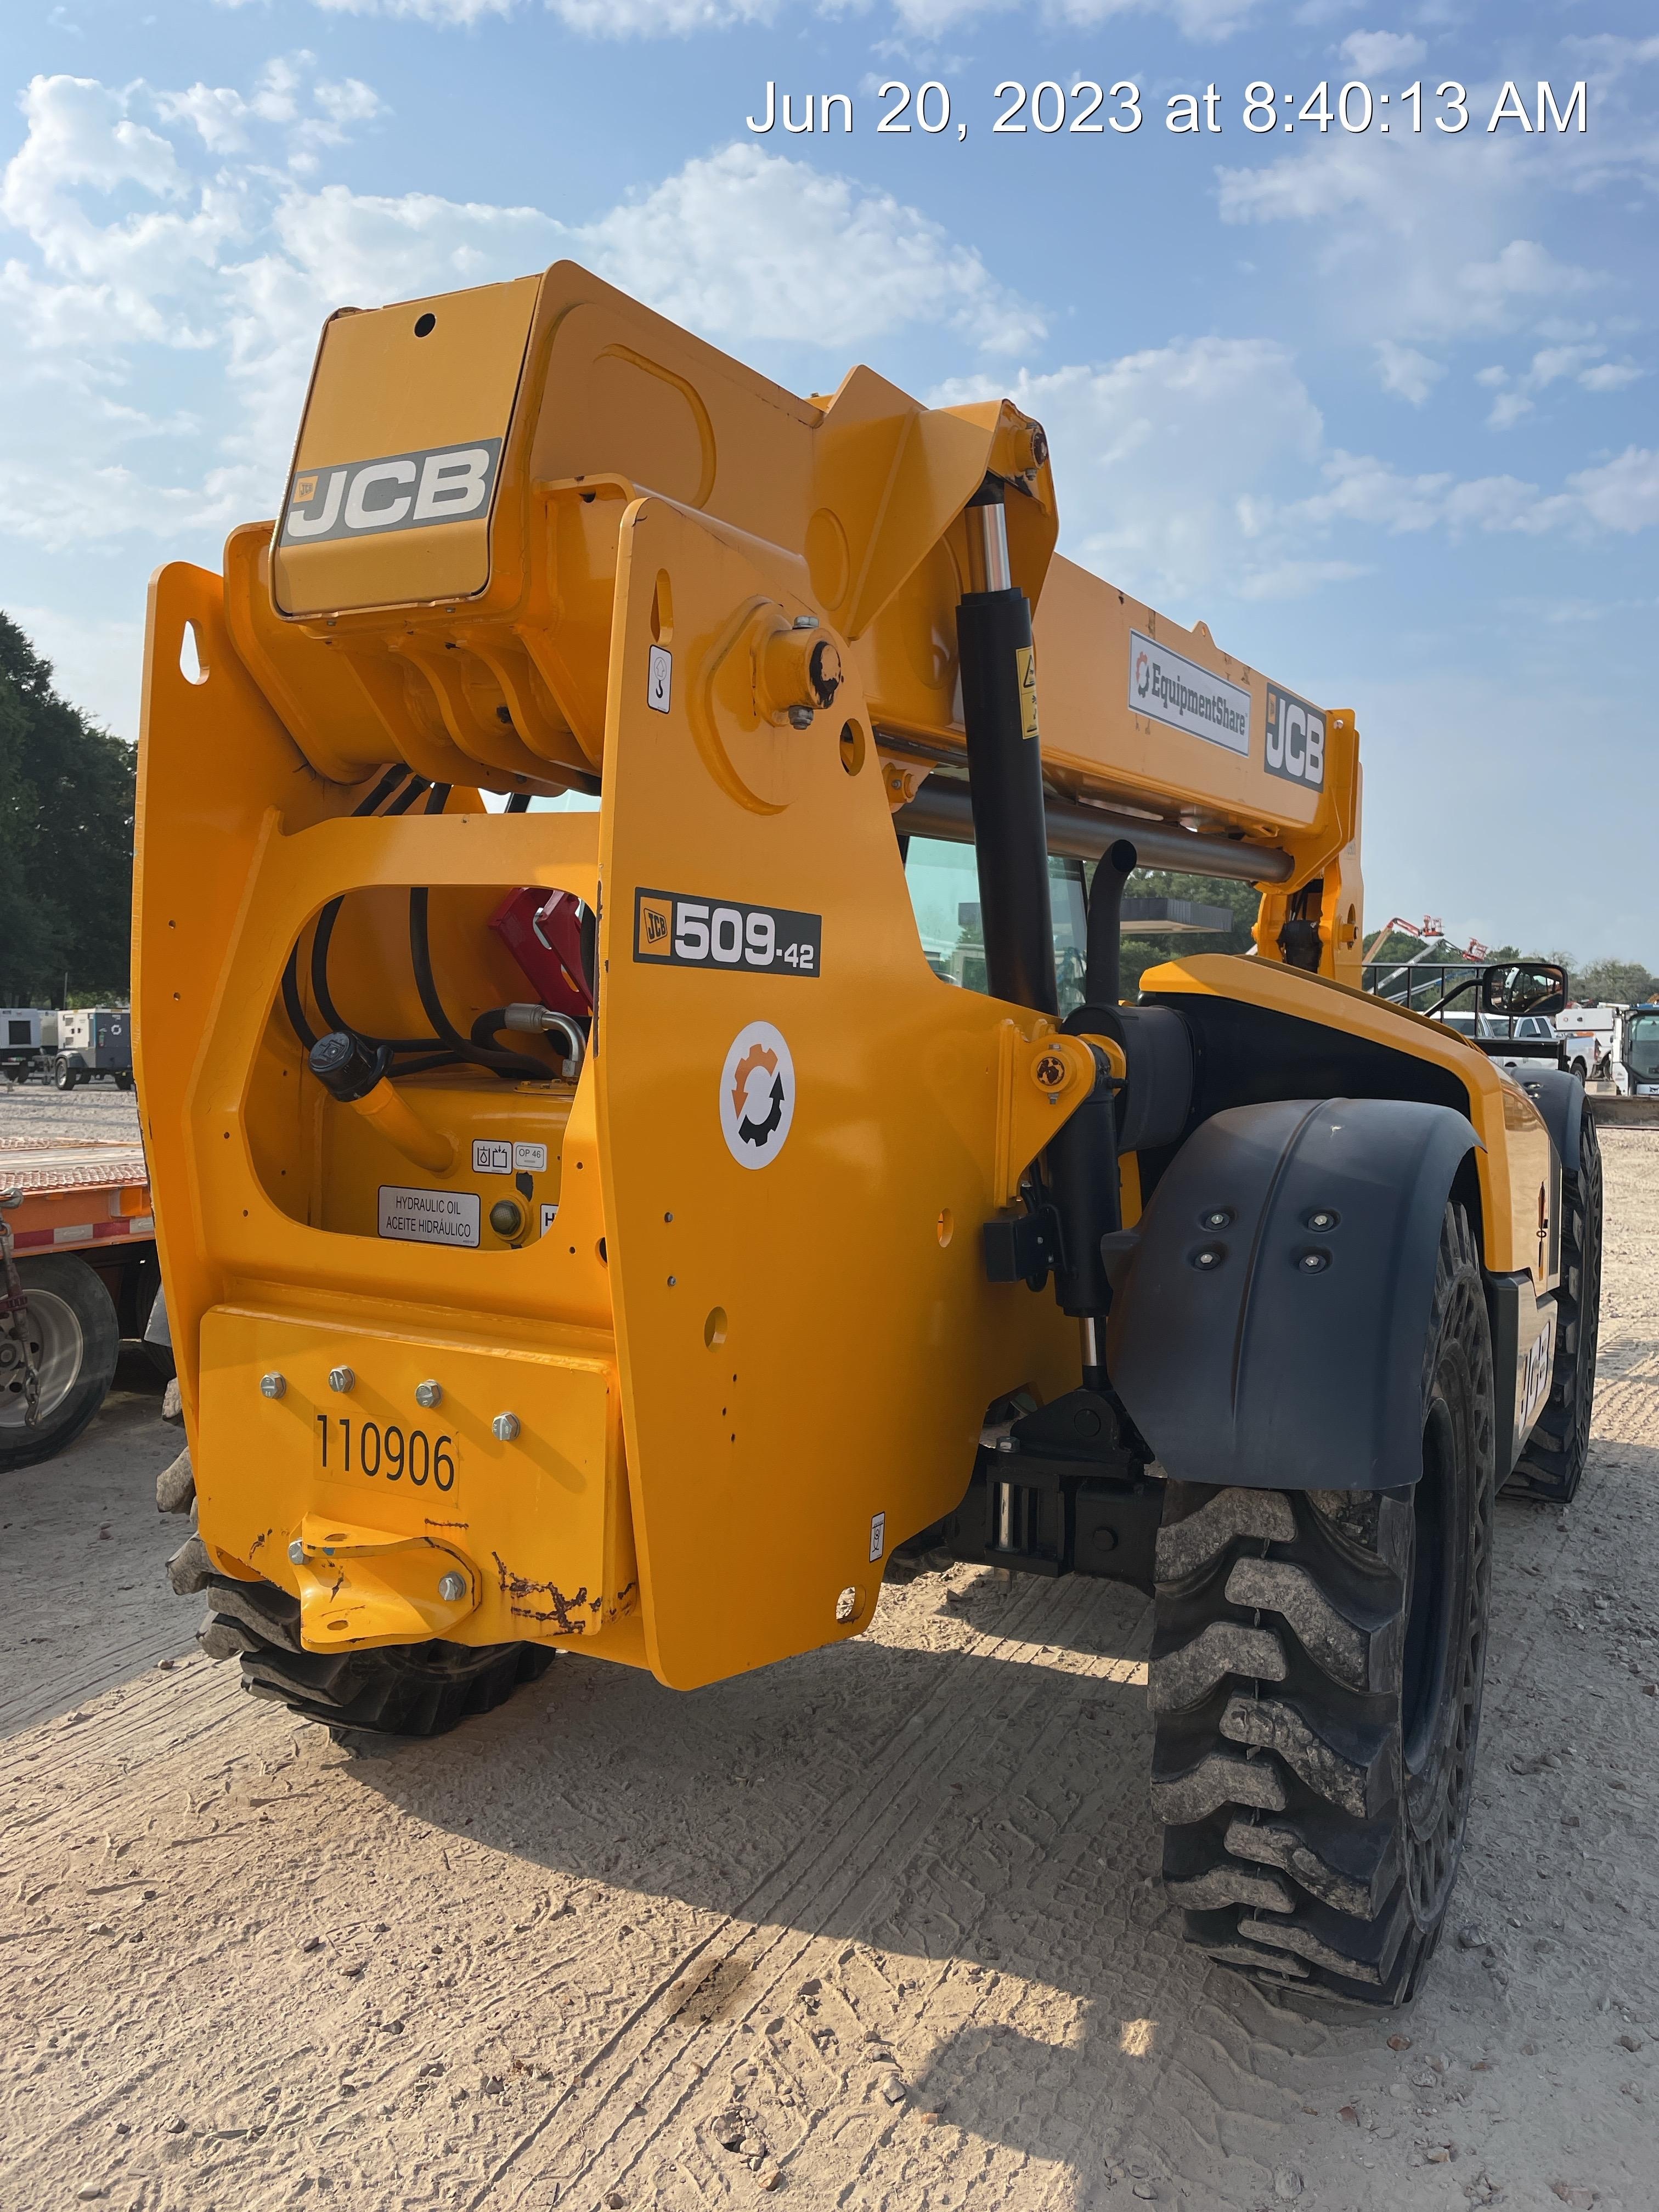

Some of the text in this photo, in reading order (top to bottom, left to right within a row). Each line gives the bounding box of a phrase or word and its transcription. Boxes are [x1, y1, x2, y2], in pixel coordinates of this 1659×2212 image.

[287, 449, 490, 537] JCB
[1152, 663, 1245, 736] EquipmentShare
[1266, 698, 1324, 785] JCB
[648, 913, 667, 940] JCB
[675, 902, 814, 969] 509-42
[519, 1148, 541, 1158] OP 46
[386, 1216, 471, 1238] ACEITE HIDRÁULICO
[396, 1195, 461, 1215] HYDRAULIC OIL
[317, 1414, 454, 1492] 110906
